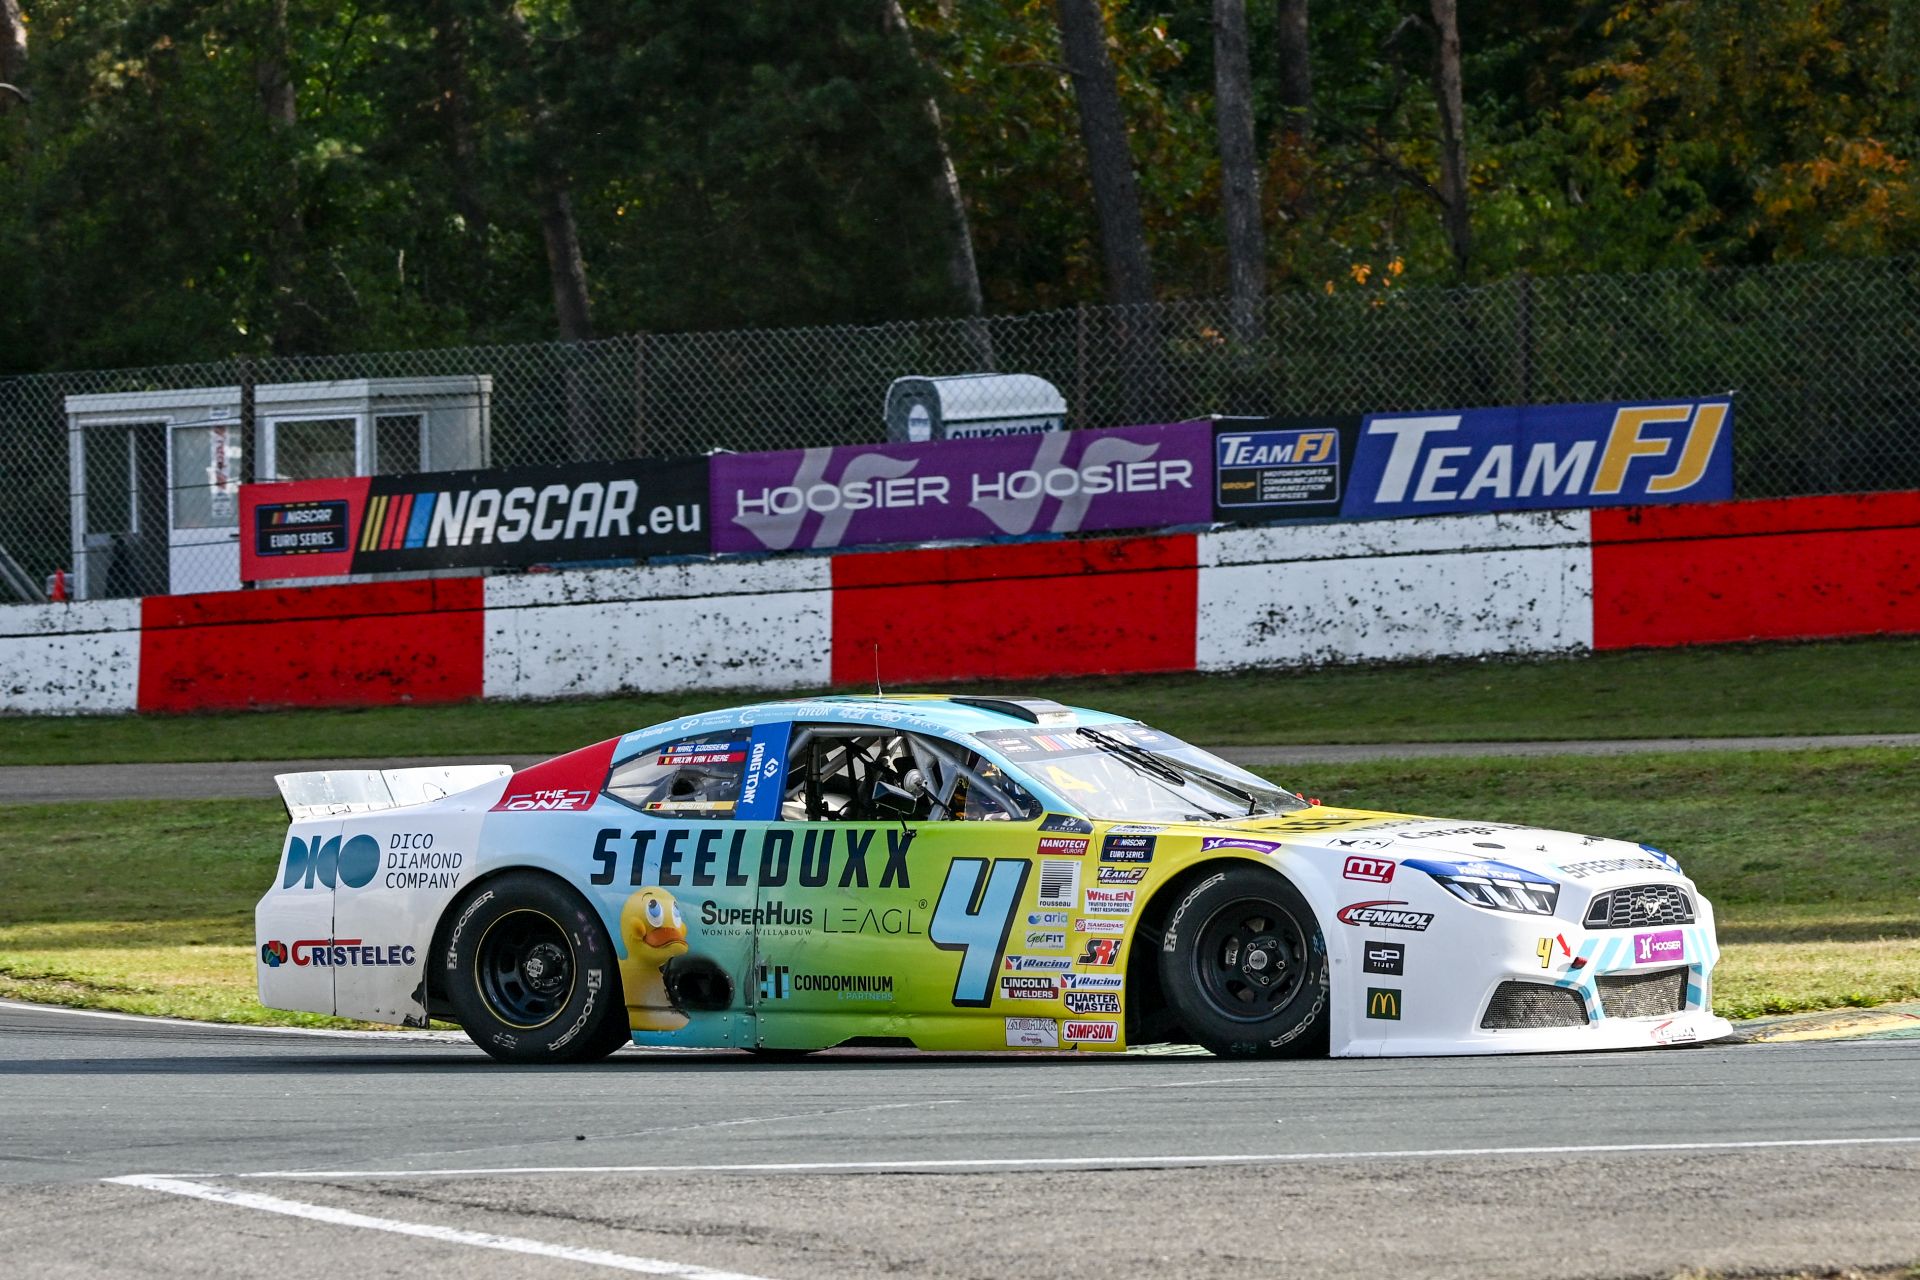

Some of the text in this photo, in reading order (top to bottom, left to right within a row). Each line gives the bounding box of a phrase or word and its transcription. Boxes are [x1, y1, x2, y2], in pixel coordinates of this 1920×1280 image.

[972, 459, 1193, 502] HOOSIER
[737, 476, 951, 517] HOOSIER
[284, 508, 332, 524] NASCAR
[427, 480, 700, 548] NASCAR.eu
[270, 531, 333, 549] EURO SERIES
[676, 743, 730, 753] MARC GOOSSENS
[693, 755, 707, 763] VAN
[743, 742, 766, 804] KING TONY
[535, 789, 568, 800] THE
[507, 798, 581, 811] ONE
[390, 833, 434, 849] DICO
[1040, 839, 1087, 849] NANOTECH
[1120, 839, 1147, 847] NASCAR
[387, 853, 463, 869] DIAMOND
[591, 828, 917, 889] STEELDUXX
[1125, 851, 1145, 859] SERIES
[385, 872, 460, 889] COMPANY
[1086, 890, 1135, 901] WHELEN
[1169, 873, 1226, 935] HOOSIER
[450, 890, 495, 952] HOOSIER
[1044, 912, 1068, 923] aria
[1344, 908, 1428, 926] KENNOL
[1373, 921, 1415, 929] PERFORMANCE
[928, 857, 1033, 1008] 4
[1536, 937, 1553, 968] 4
[1652, 940, 1681, 952] HOOSIER
[1022, 958, 1071, 969] iRacing
[1373, 961, 1395, 969] TIJEY
[794, 975, 893, 992] CONDOMINIUM
[1003, 978, 1049, 988] LINCOLN
[1077, 976, 1122, 987] iRacing
[846, 992, 893, 1001] PARTNERS
[1013, 989, 1054, 998] WELDERS
[1065, 993, 1116, 1006] QUARTER
[1074, 1002, 1119, 1012] MASTER
[547, 988, 597, 1051] HOOSIER
[1066, 1023, 1114, 1039] SIMPSON
